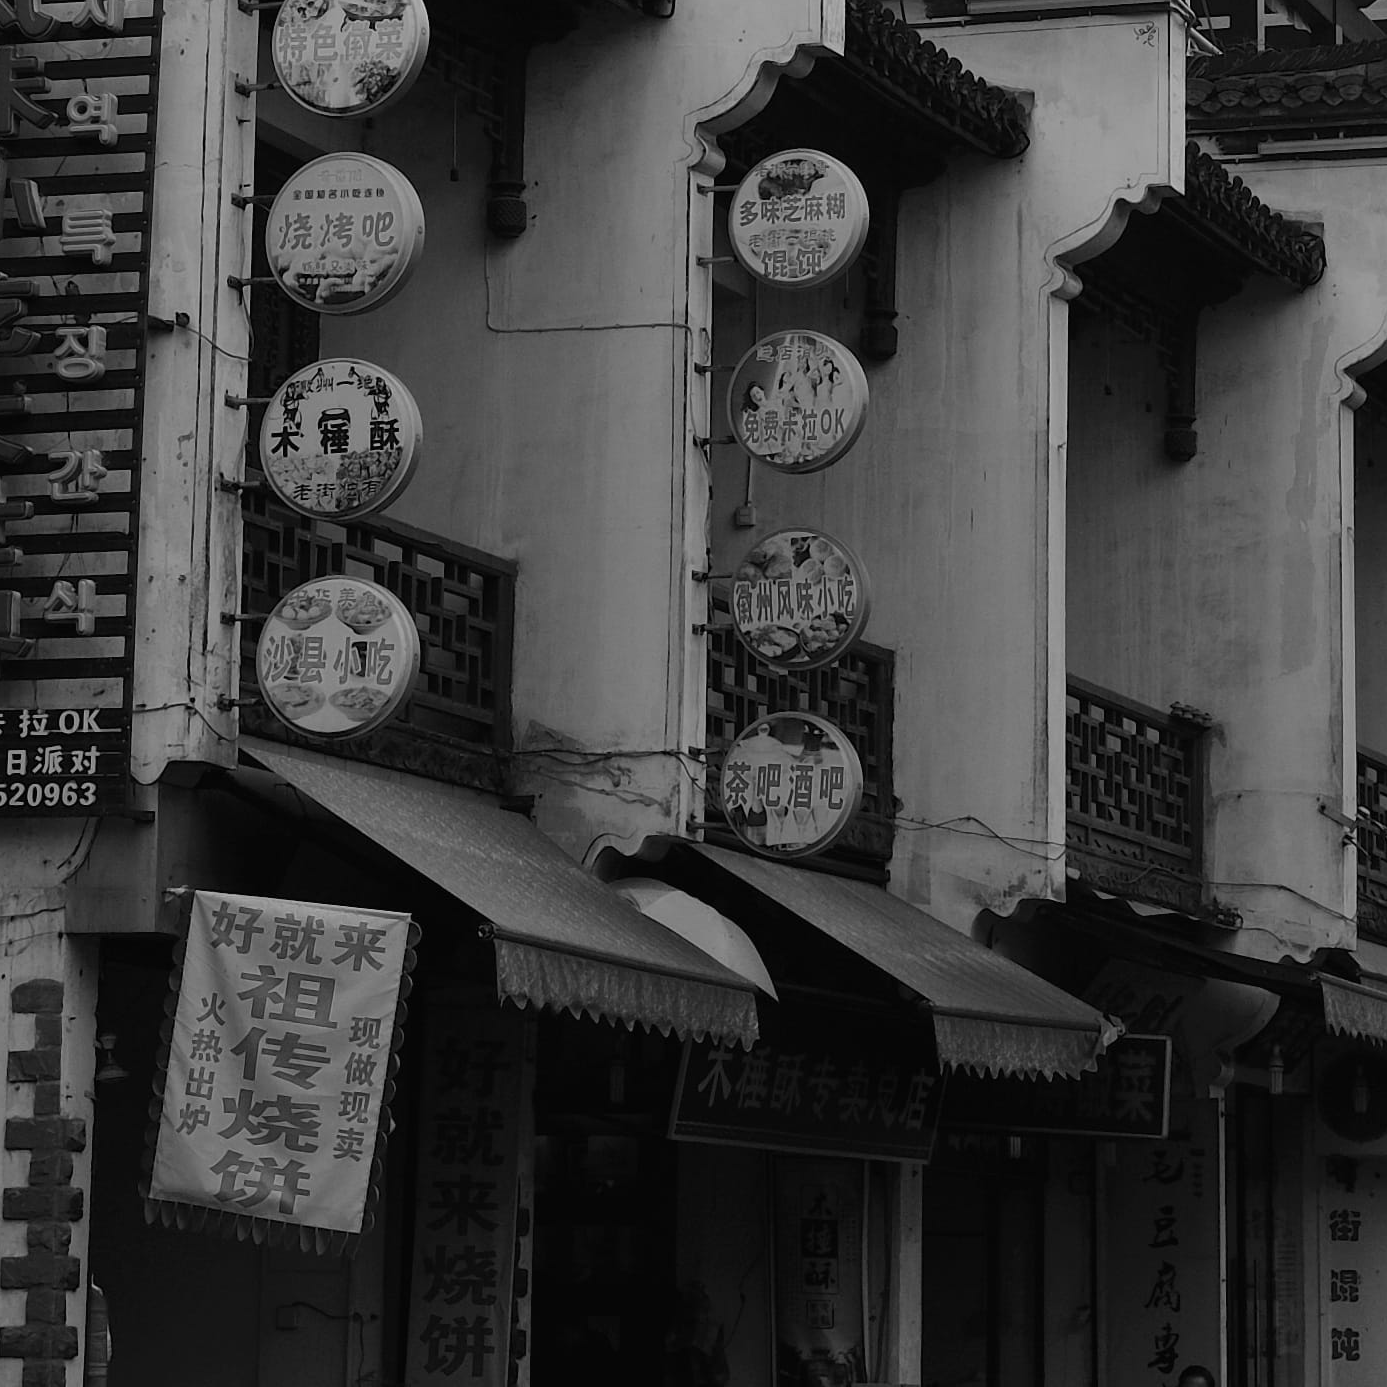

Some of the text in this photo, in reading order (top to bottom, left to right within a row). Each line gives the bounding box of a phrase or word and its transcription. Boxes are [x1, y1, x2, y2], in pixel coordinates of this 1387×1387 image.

[278, 22, 404, 63] 特色徽菜
[279, 211, 396, 251] 烧烤吧
[739, 192, 847, 227] 多味芝麻糊
[761, 249, 824, 278] 馄饨
[743, 408, 846, 445] 免费卡拉OK
[736, 575, 855, 625] 徽州风味小吃
[263, 635, 395, 686] 沙县小吃
[725, 761, 845, 810] 茶吧酒吧
[211, 901, 387, 972] 好就来
[176, 991, 226, 1135] 火热出炉
[209, 964, 338, 1215] 祖传烧饼
[333, 1015, 382, 1162] 现做现卖
[420, 1035, 511, 1377] 好就来烧饼
